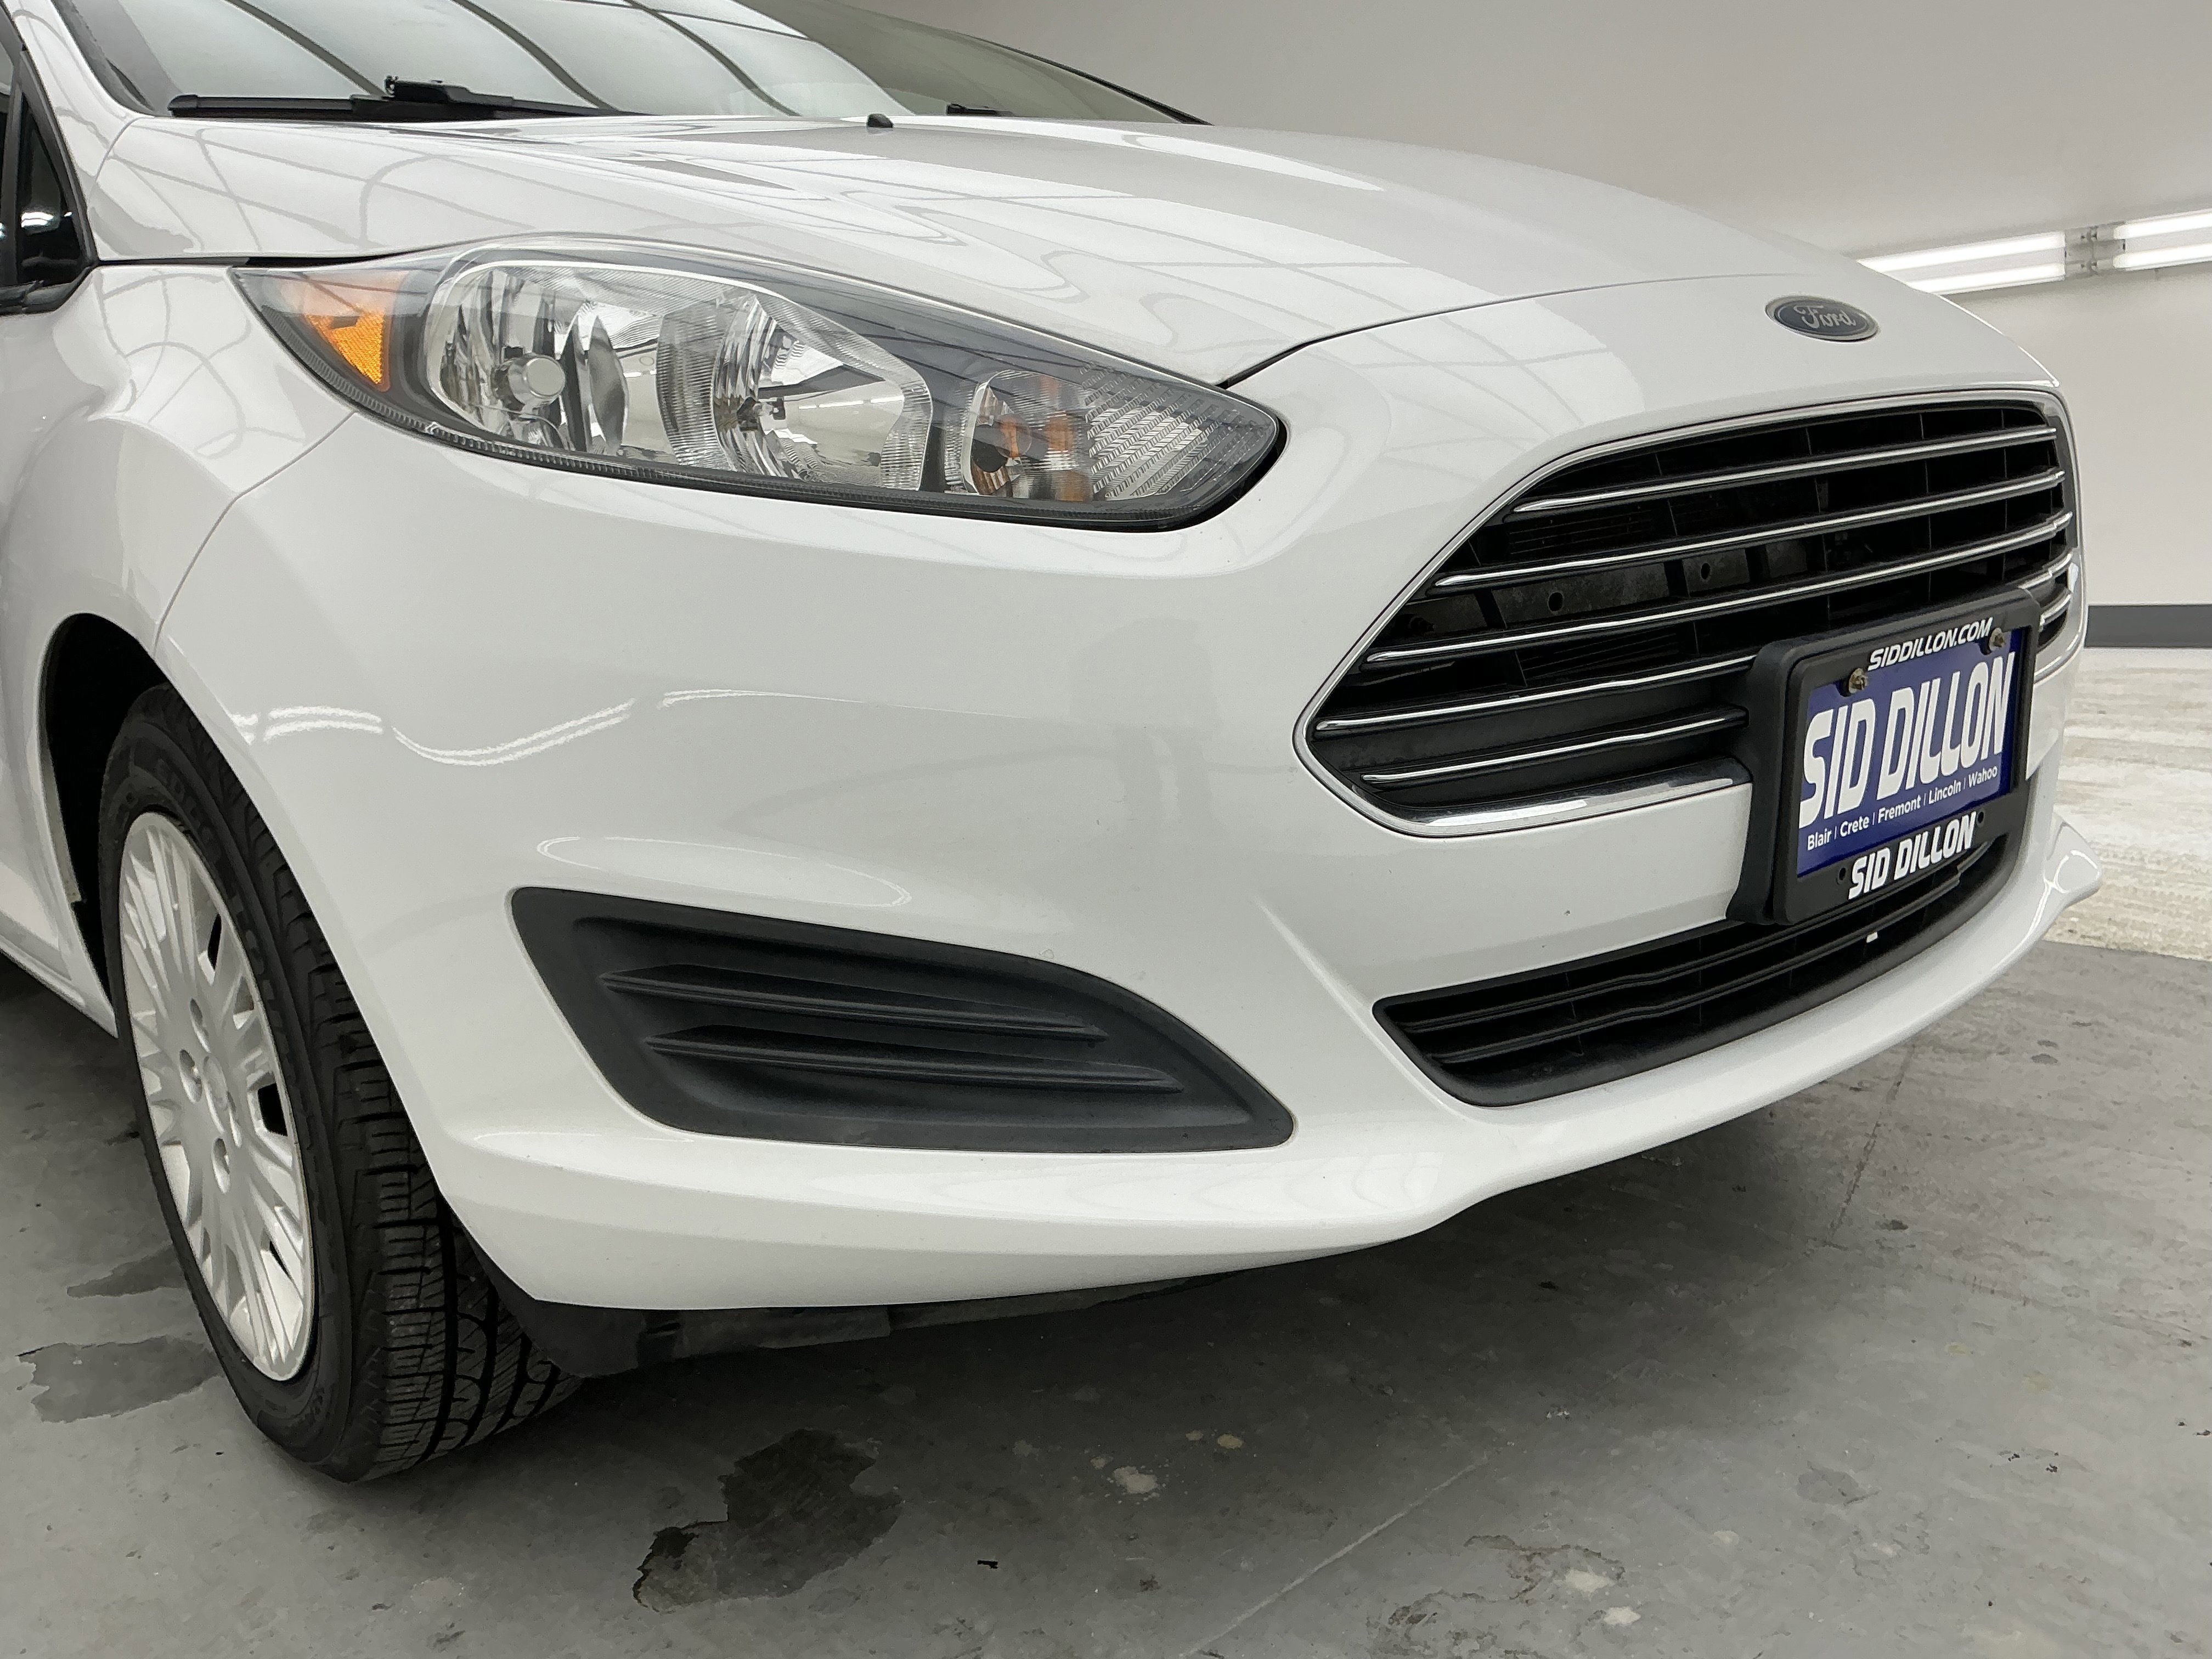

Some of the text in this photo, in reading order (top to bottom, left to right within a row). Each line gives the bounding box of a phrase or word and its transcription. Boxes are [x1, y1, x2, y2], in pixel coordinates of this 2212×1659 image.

[1793, 304, 1856, 329] Ford
[1867, 617, 1993, 672] SIDDILLON.COM
[1799, 652, 2015, 828] SID DILLON
[1807, 765, 1998, 851] Blair Crete Fremont Lincoln Wahoo
[1848, 811, 1977, 900] SID DILLON
